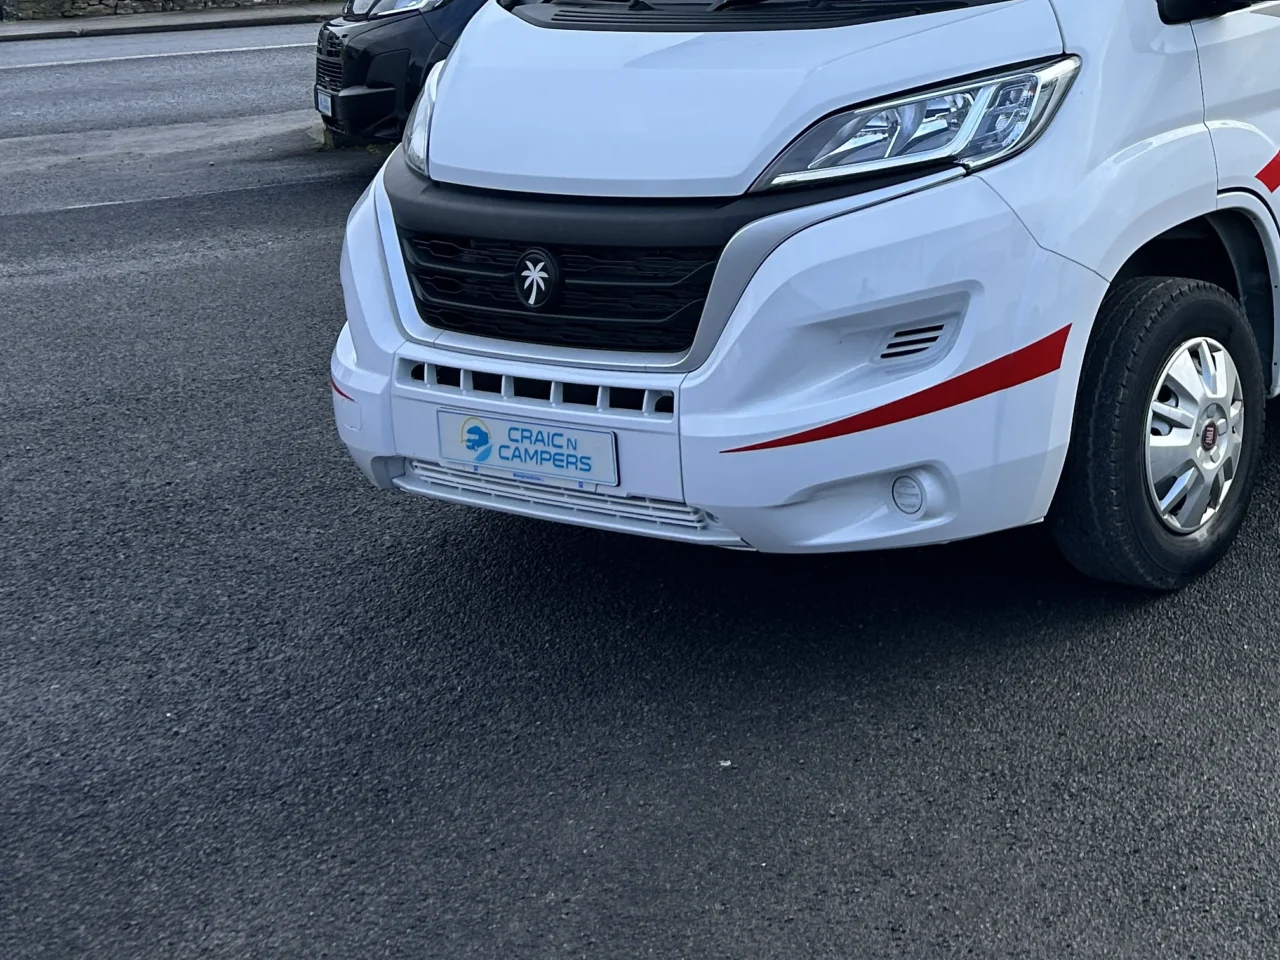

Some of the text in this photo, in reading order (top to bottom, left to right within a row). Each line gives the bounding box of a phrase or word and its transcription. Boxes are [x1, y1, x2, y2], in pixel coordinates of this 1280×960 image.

[508, 426, 578, 451] CRAIC N
[498, 445, 592, 472] CAMPERS
